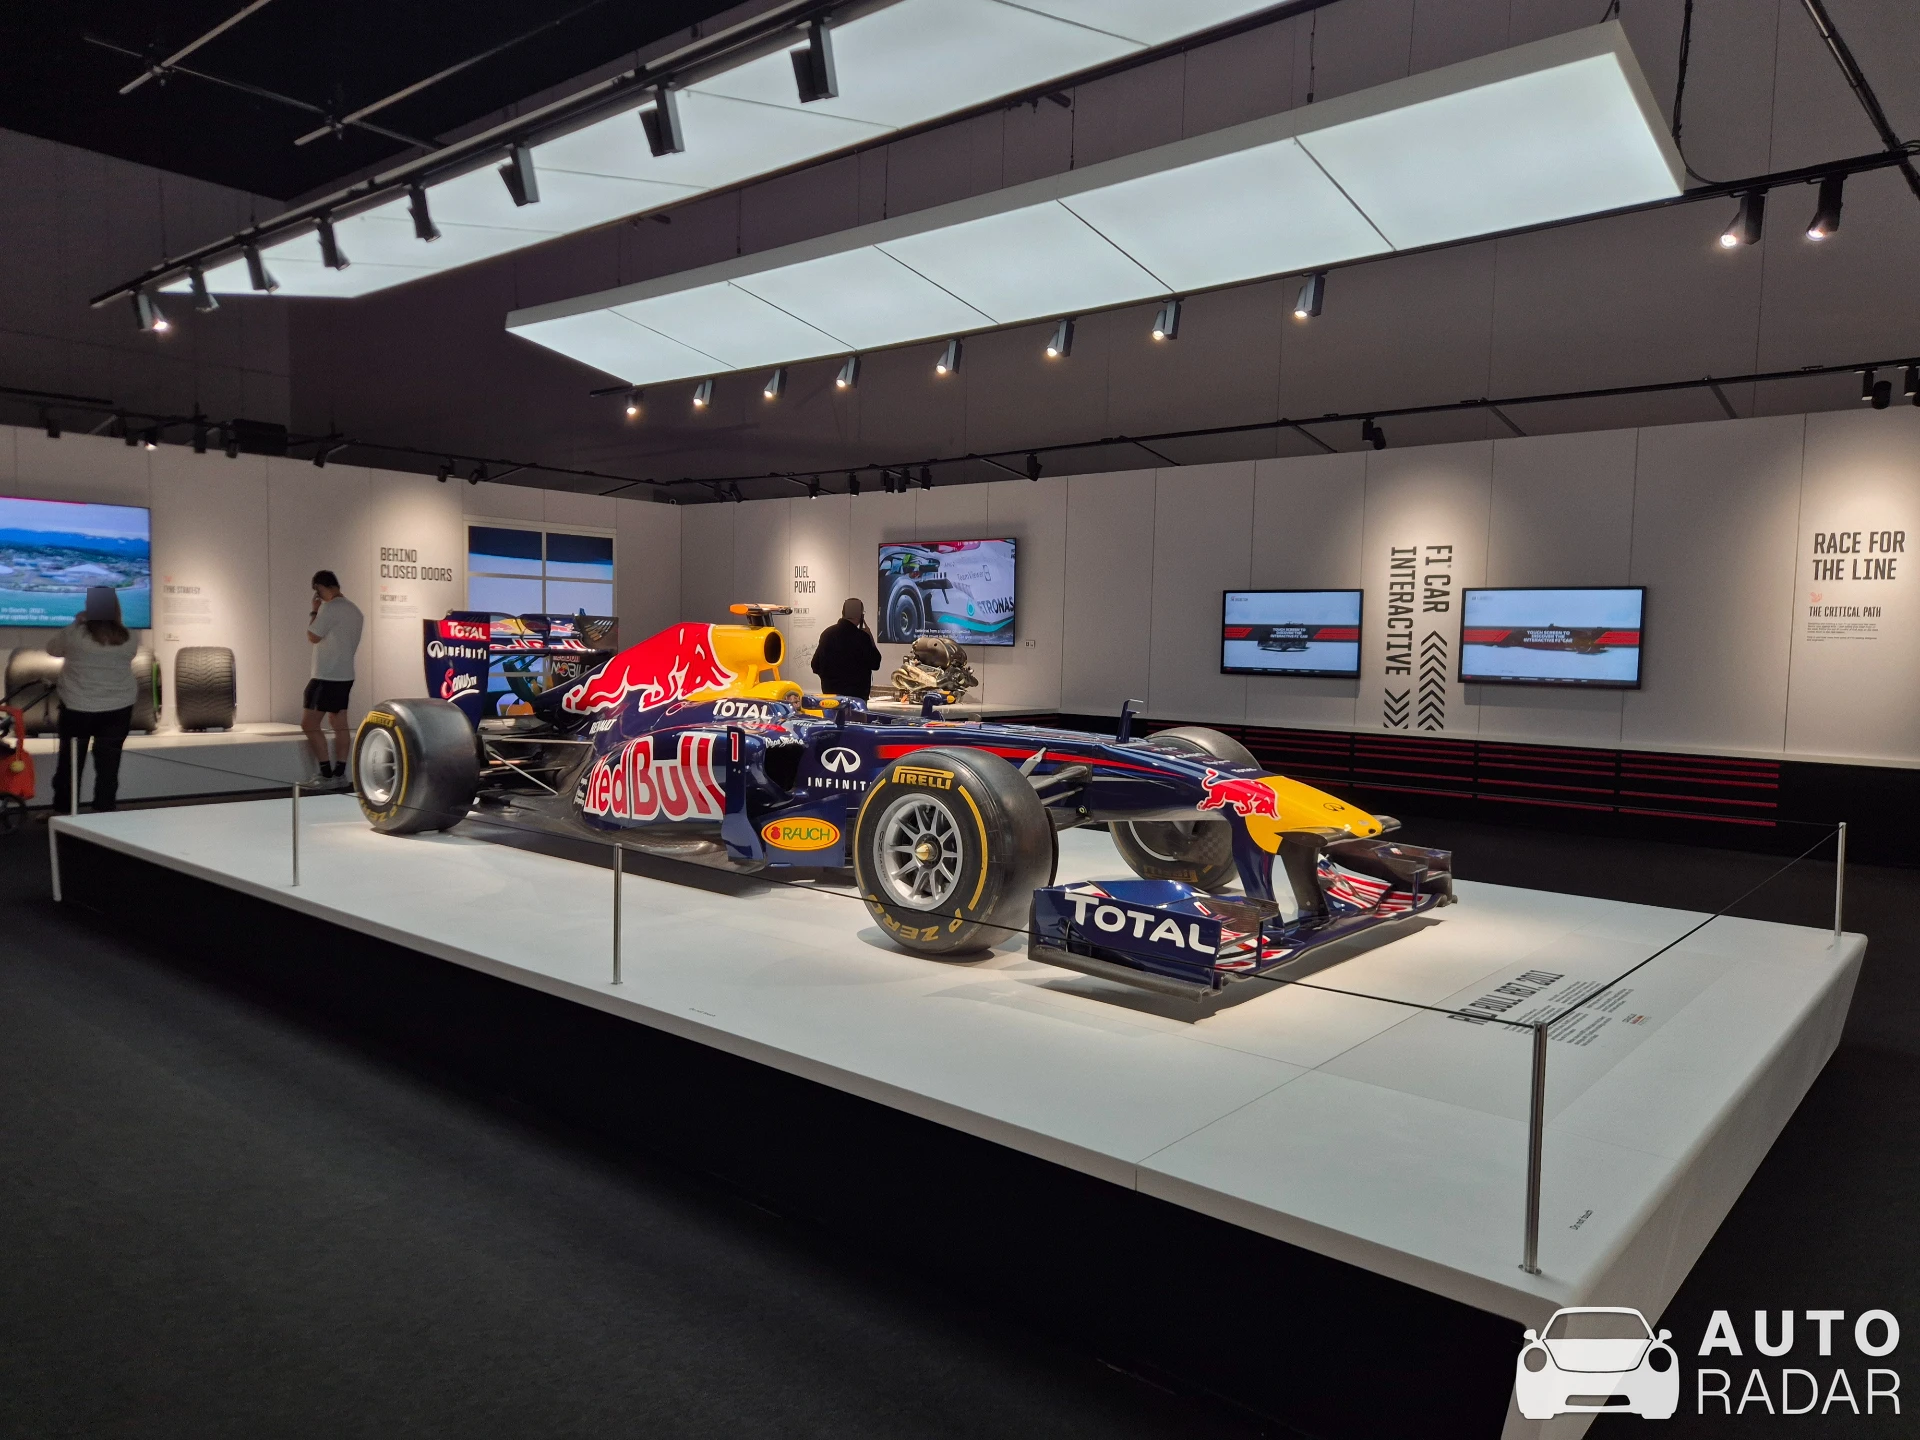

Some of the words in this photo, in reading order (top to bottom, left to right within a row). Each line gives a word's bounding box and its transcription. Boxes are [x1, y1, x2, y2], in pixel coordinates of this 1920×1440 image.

[1813, 532, 1861, 554] RACE
[1868, 531, 1905, 553] FOR
[380, 547, 417, 563] BEHIND
[380, 564, 417, 580] CLOSED
[421, 567, 453, 582] DOORS
[794, 566, 809, 578] DUEL
[1812, 559, 1845, 580] THE
[1851, 558, 1897, 580] LINE
[794, 581, 816, 593] POWER
[1422, 574, 1451, 612] CAR
[1385, 546, 1417, 676] INTERACTIVE
[1809, 606, 1822, 617] THE
[1824, 606, 1860, 617] CRITICAL
[1863, 606, 1881, 618] PATH
[448, 621, 487, 640] TOTAL
[445, 645, 487, 660] INFINITI
[712, 699, 773, 720] TOTAL
[730, 732, 738, 762] 1
[807, 776, 873, 792] INFINIT
[892, 765, 955, 790] PIRELLI
[783, 827, 831, 842] RAUCH
[1064, 892, 1216, 955] TOTAL
